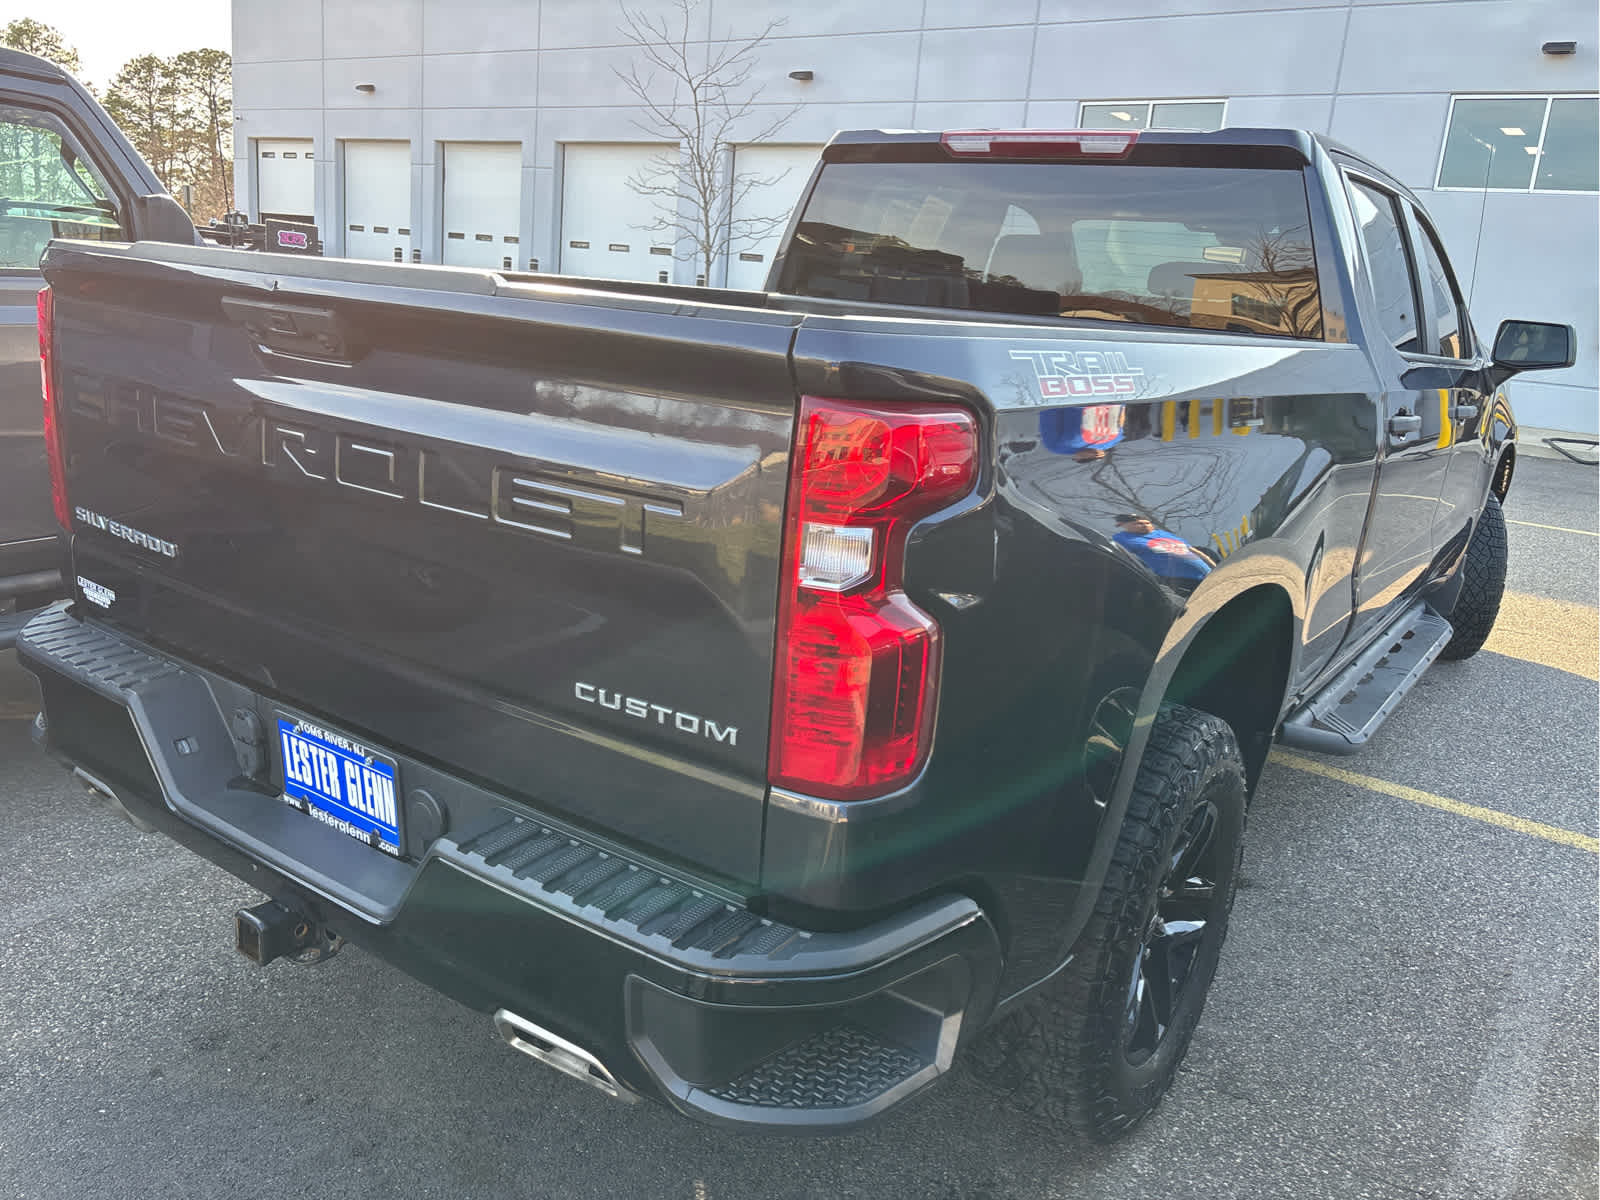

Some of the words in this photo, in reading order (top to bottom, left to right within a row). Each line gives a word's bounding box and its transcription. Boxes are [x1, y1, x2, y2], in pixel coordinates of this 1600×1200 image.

[1008, 350, 1144, 378] TRAIL
[1038, 375, 1136, 398] BOSS
[70, 370, 684, 555] CHEVROLET
[75, 506, 177, 558] SILVERADO
[298, 719, 323, 740] TOMS
[575, 682, 738, 746] CUSTOM
[282, 733, 342, 801] LESTER
[344, 759, 397, 828] GLENN
